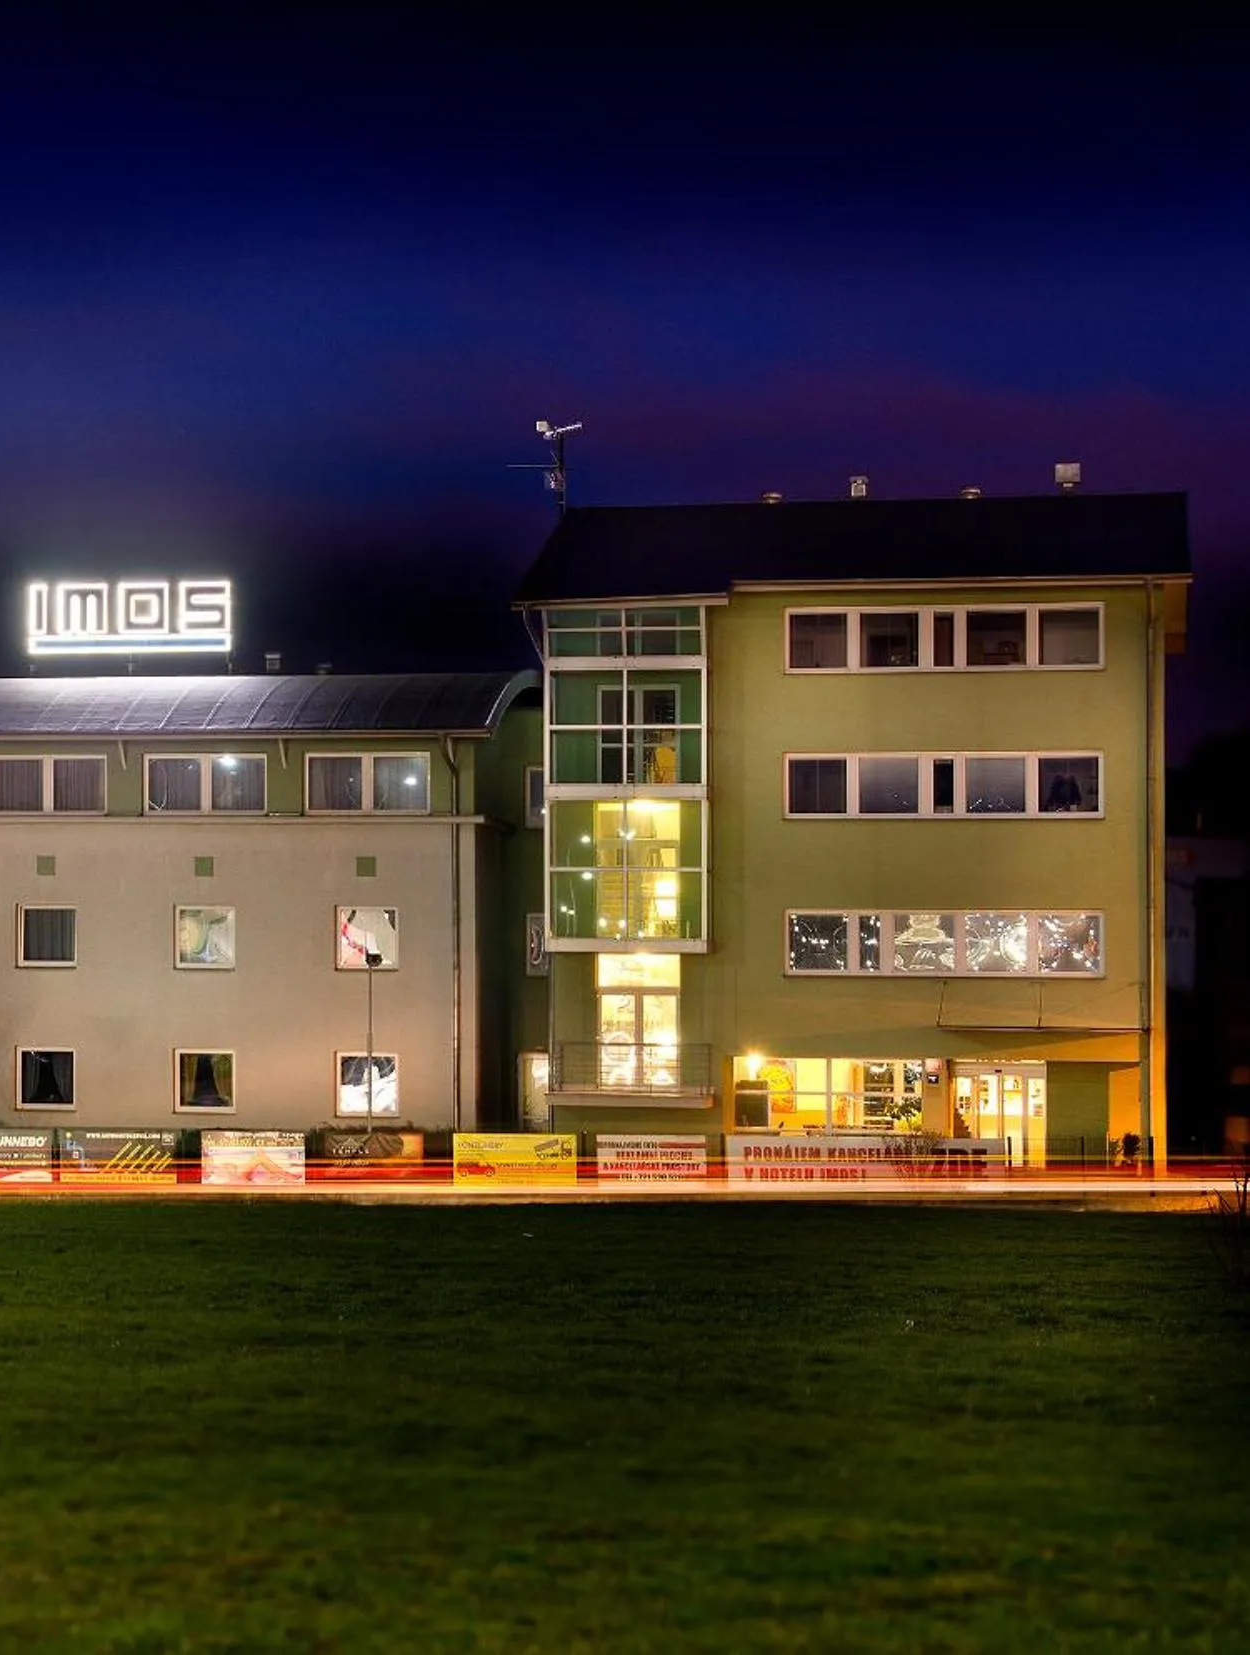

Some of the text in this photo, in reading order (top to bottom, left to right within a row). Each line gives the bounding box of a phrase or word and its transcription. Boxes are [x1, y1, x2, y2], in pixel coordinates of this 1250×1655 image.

[28, 579, 231, 635] IMOS
[744, 1145, 821, 1162] PRONÁJEM
[759, 1167, 815, 1182] HOTELU
